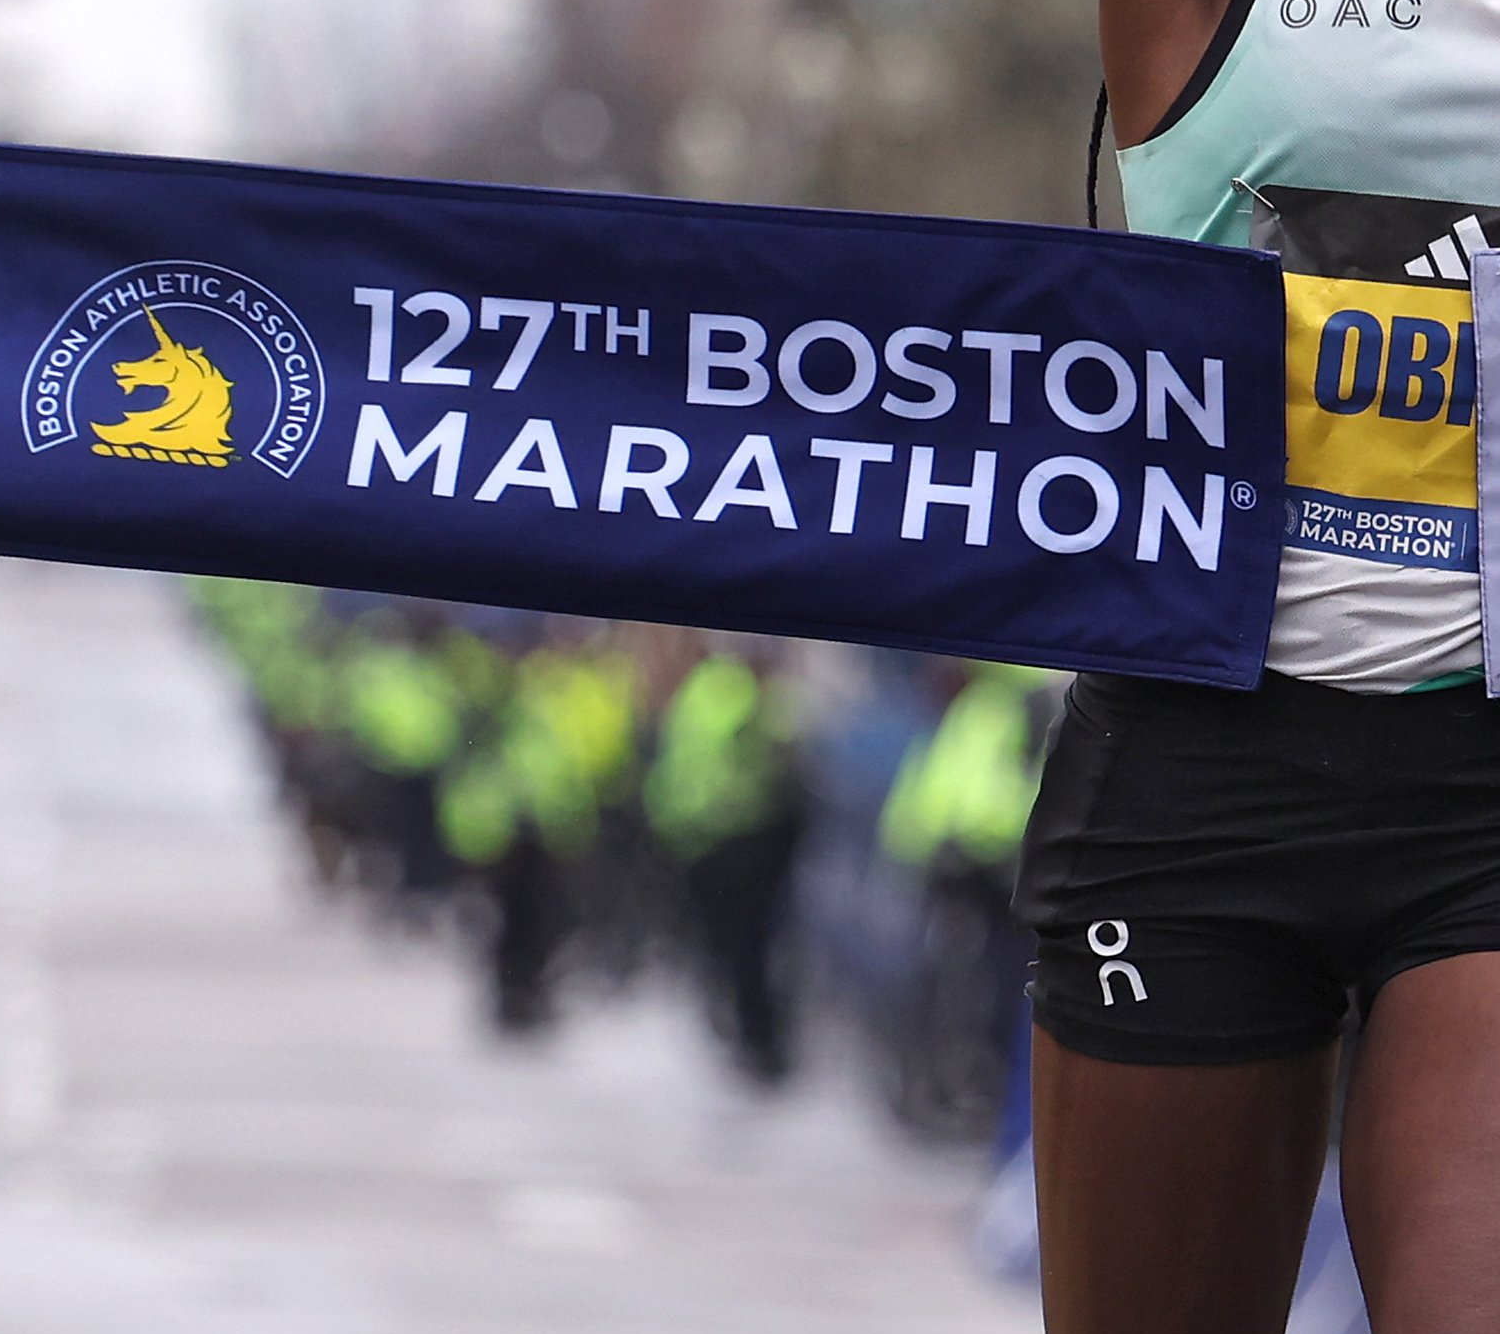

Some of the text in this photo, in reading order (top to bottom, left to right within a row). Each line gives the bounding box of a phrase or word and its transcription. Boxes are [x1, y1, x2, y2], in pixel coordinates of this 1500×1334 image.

[35, 272, 313, 463] BOSTON ATHLETIC ASSOCIATION
[352, 285, 1228, 449] 127TH BOSTON
[1301, 499, 1352, 524] 127TH
[1355, 511, 1453, 538] BOSTON
